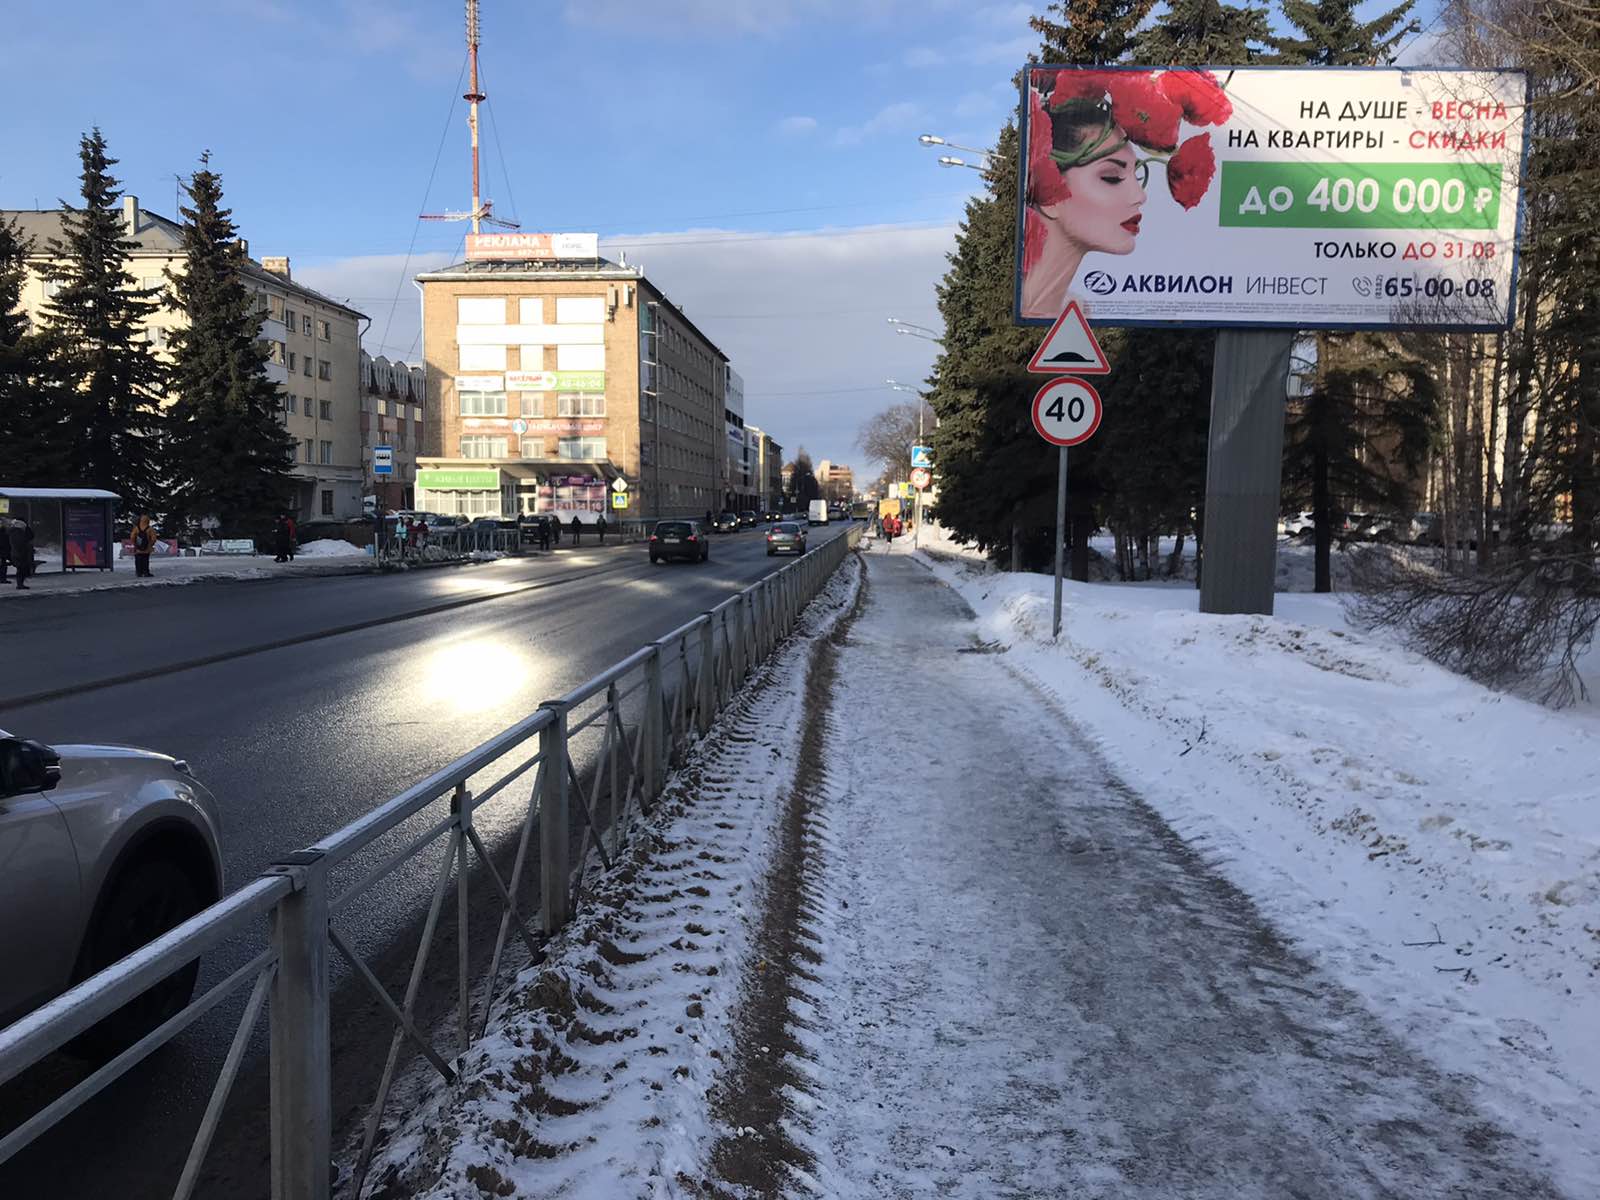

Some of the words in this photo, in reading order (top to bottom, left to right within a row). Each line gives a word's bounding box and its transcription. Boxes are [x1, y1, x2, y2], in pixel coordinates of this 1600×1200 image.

[1299, 101, 1331, 119] НА
[1338, 101, 1408, 122] ДУШЕ
[1432, 101, 1508, 121] ВЕСНА
[1228, 129, 1260, 149] НА
[1267, 130, 1384, 149] КВАРТИРЫ
[1408, 130, 1506, 151] СКИДКИ
[1307, 177, 1380, 213] 400
[1393, 177, 1466, 214] 000
[474, 235, 541, 248] РЕКЛАМА
[1314, 241, 1397, 259] ТОЛЬКО
[1402, 241, 1437, 261] ДО
[1443, 241, 1497, 260] 31.03
[1121, 274, 1233, 295] АКВИЛОН
[1246, 277, 1328, 296] ИНВЕСТ
[1384, 276, 1495, 298] 65-00-08
[1045, 396, 1085, 423] 40
